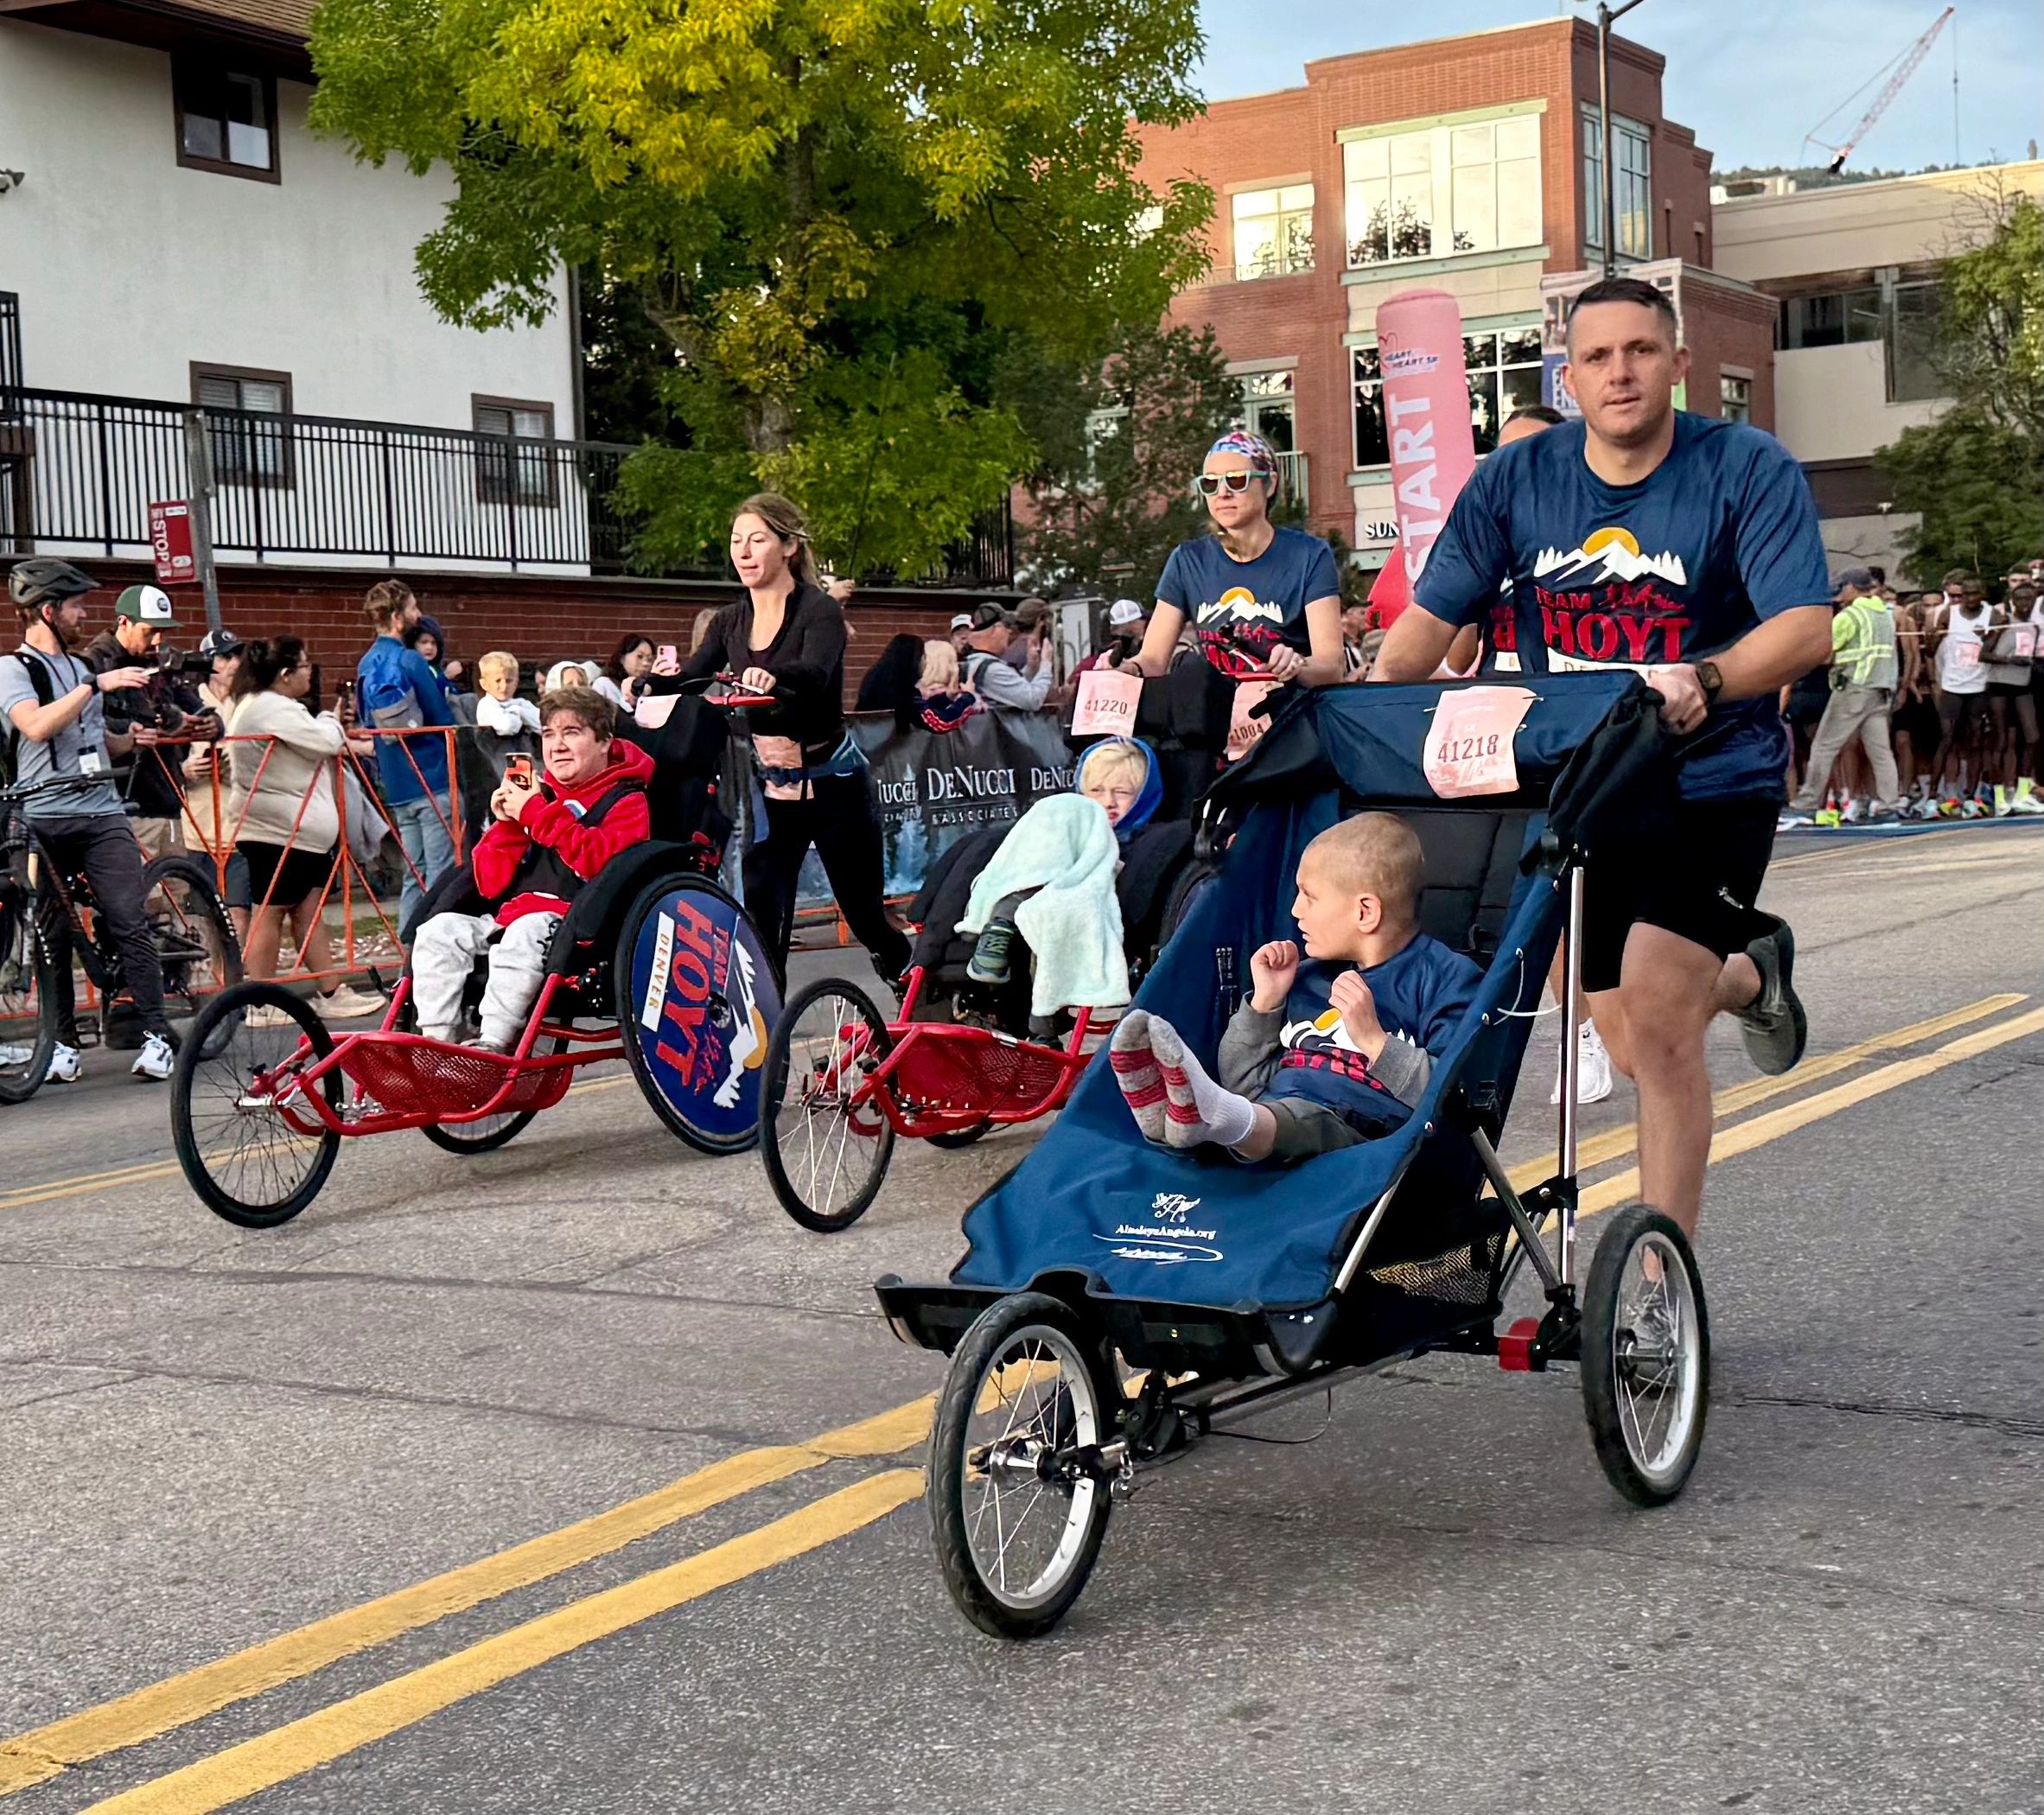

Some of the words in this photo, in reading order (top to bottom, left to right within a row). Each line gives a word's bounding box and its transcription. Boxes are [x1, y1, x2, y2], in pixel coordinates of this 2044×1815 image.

[1390, 392, 1442, 589] START
[152, 519, 170, 562] STOP
[1534, 585, 1591, 609] TEAM
[1541, 606, 1691, 661] HOYT
[1084, 699, 1128, 715] 41220
[1437, 734, 1499, 762] 41218
[648, 933, 670, 1009] DENVER
[714, 927, 729, 987] TEAM
[656, 900, 713, 1086] HOYT
